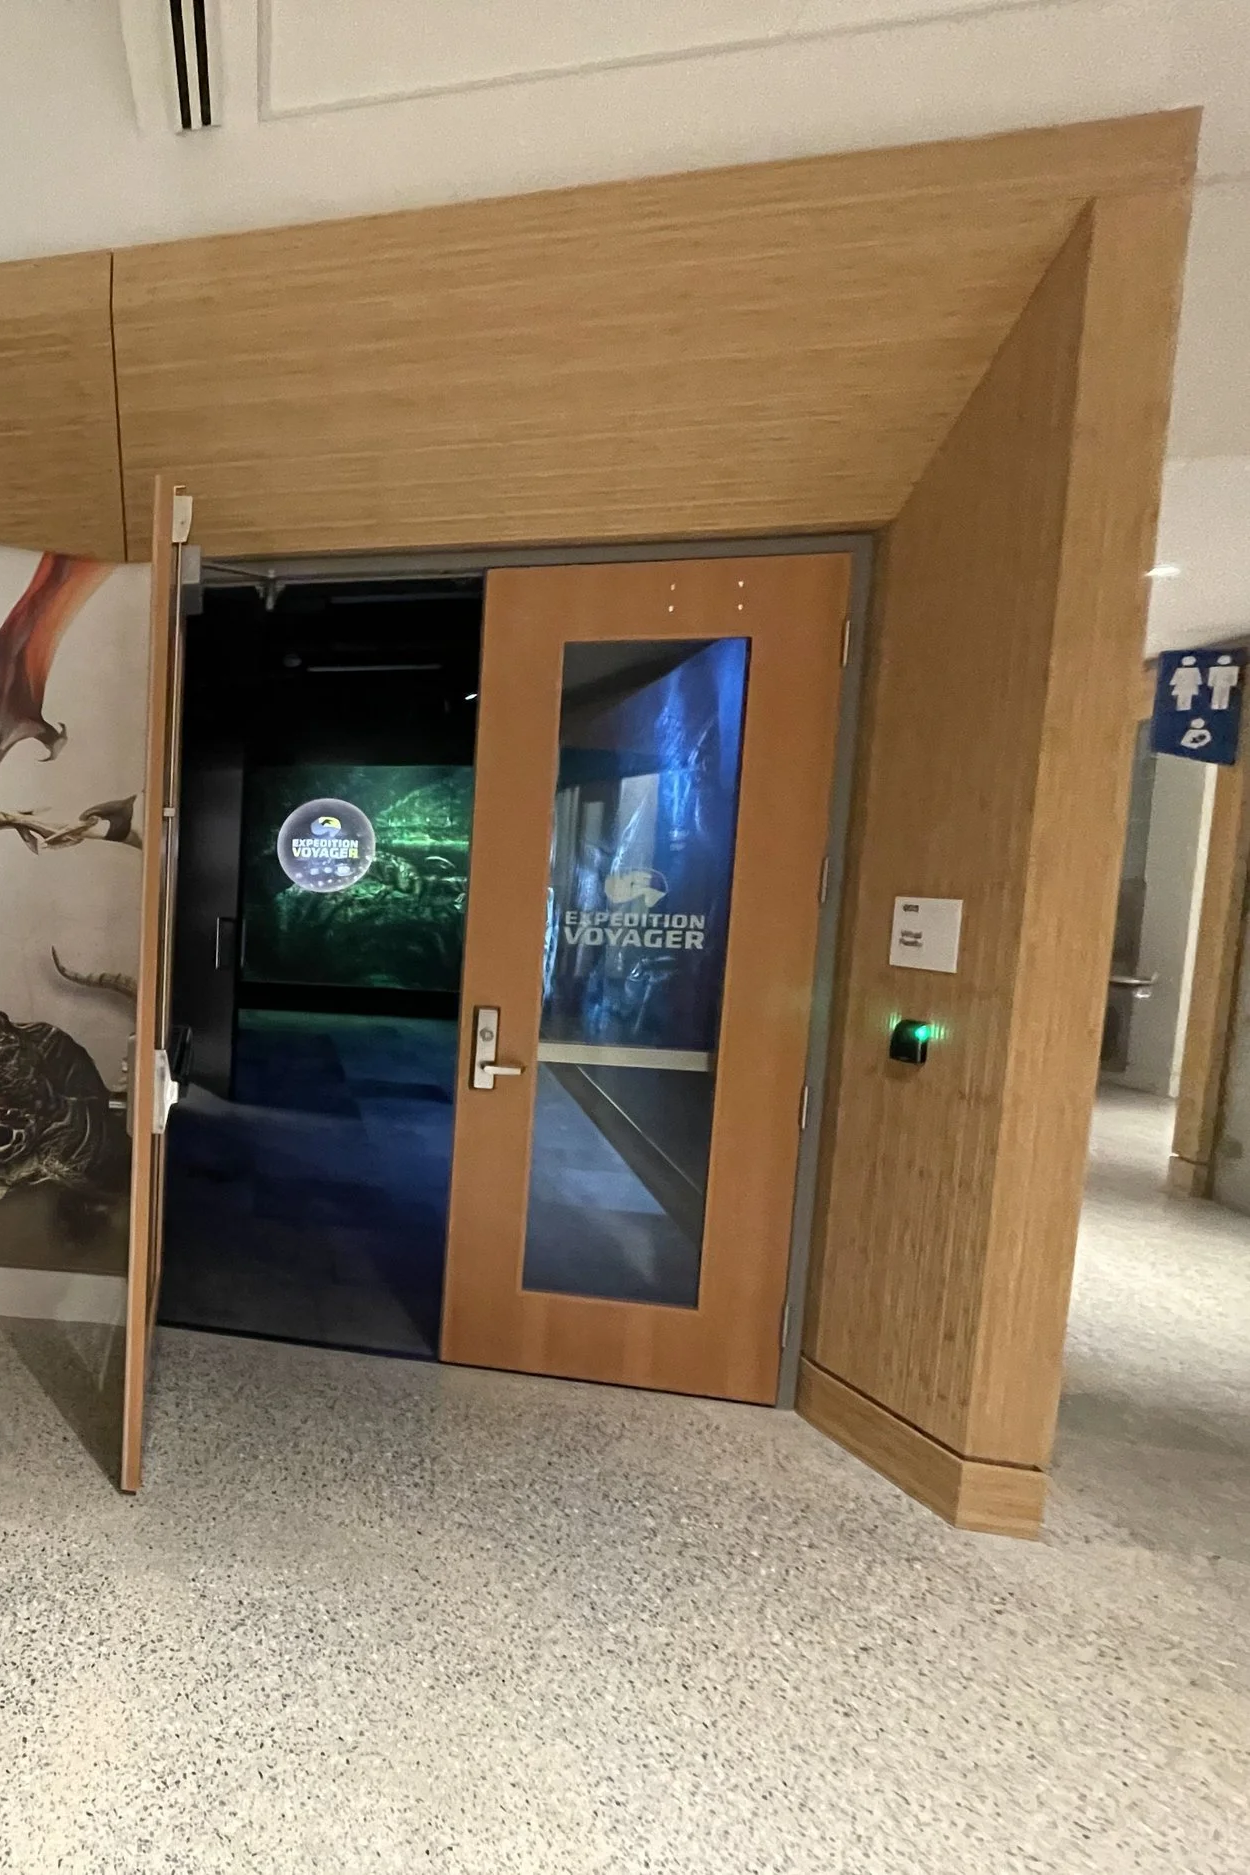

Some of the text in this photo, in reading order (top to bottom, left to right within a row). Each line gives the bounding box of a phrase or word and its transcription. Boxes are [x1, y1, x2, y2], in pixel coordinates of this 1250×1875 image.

[292, 839, 358, 849] EXPEDITION
[292, 847, 359, 859] VOYAGER
[565, 910, 705, 929] EXPEDITION
[564, 926, 705, 950] VOYAGER
